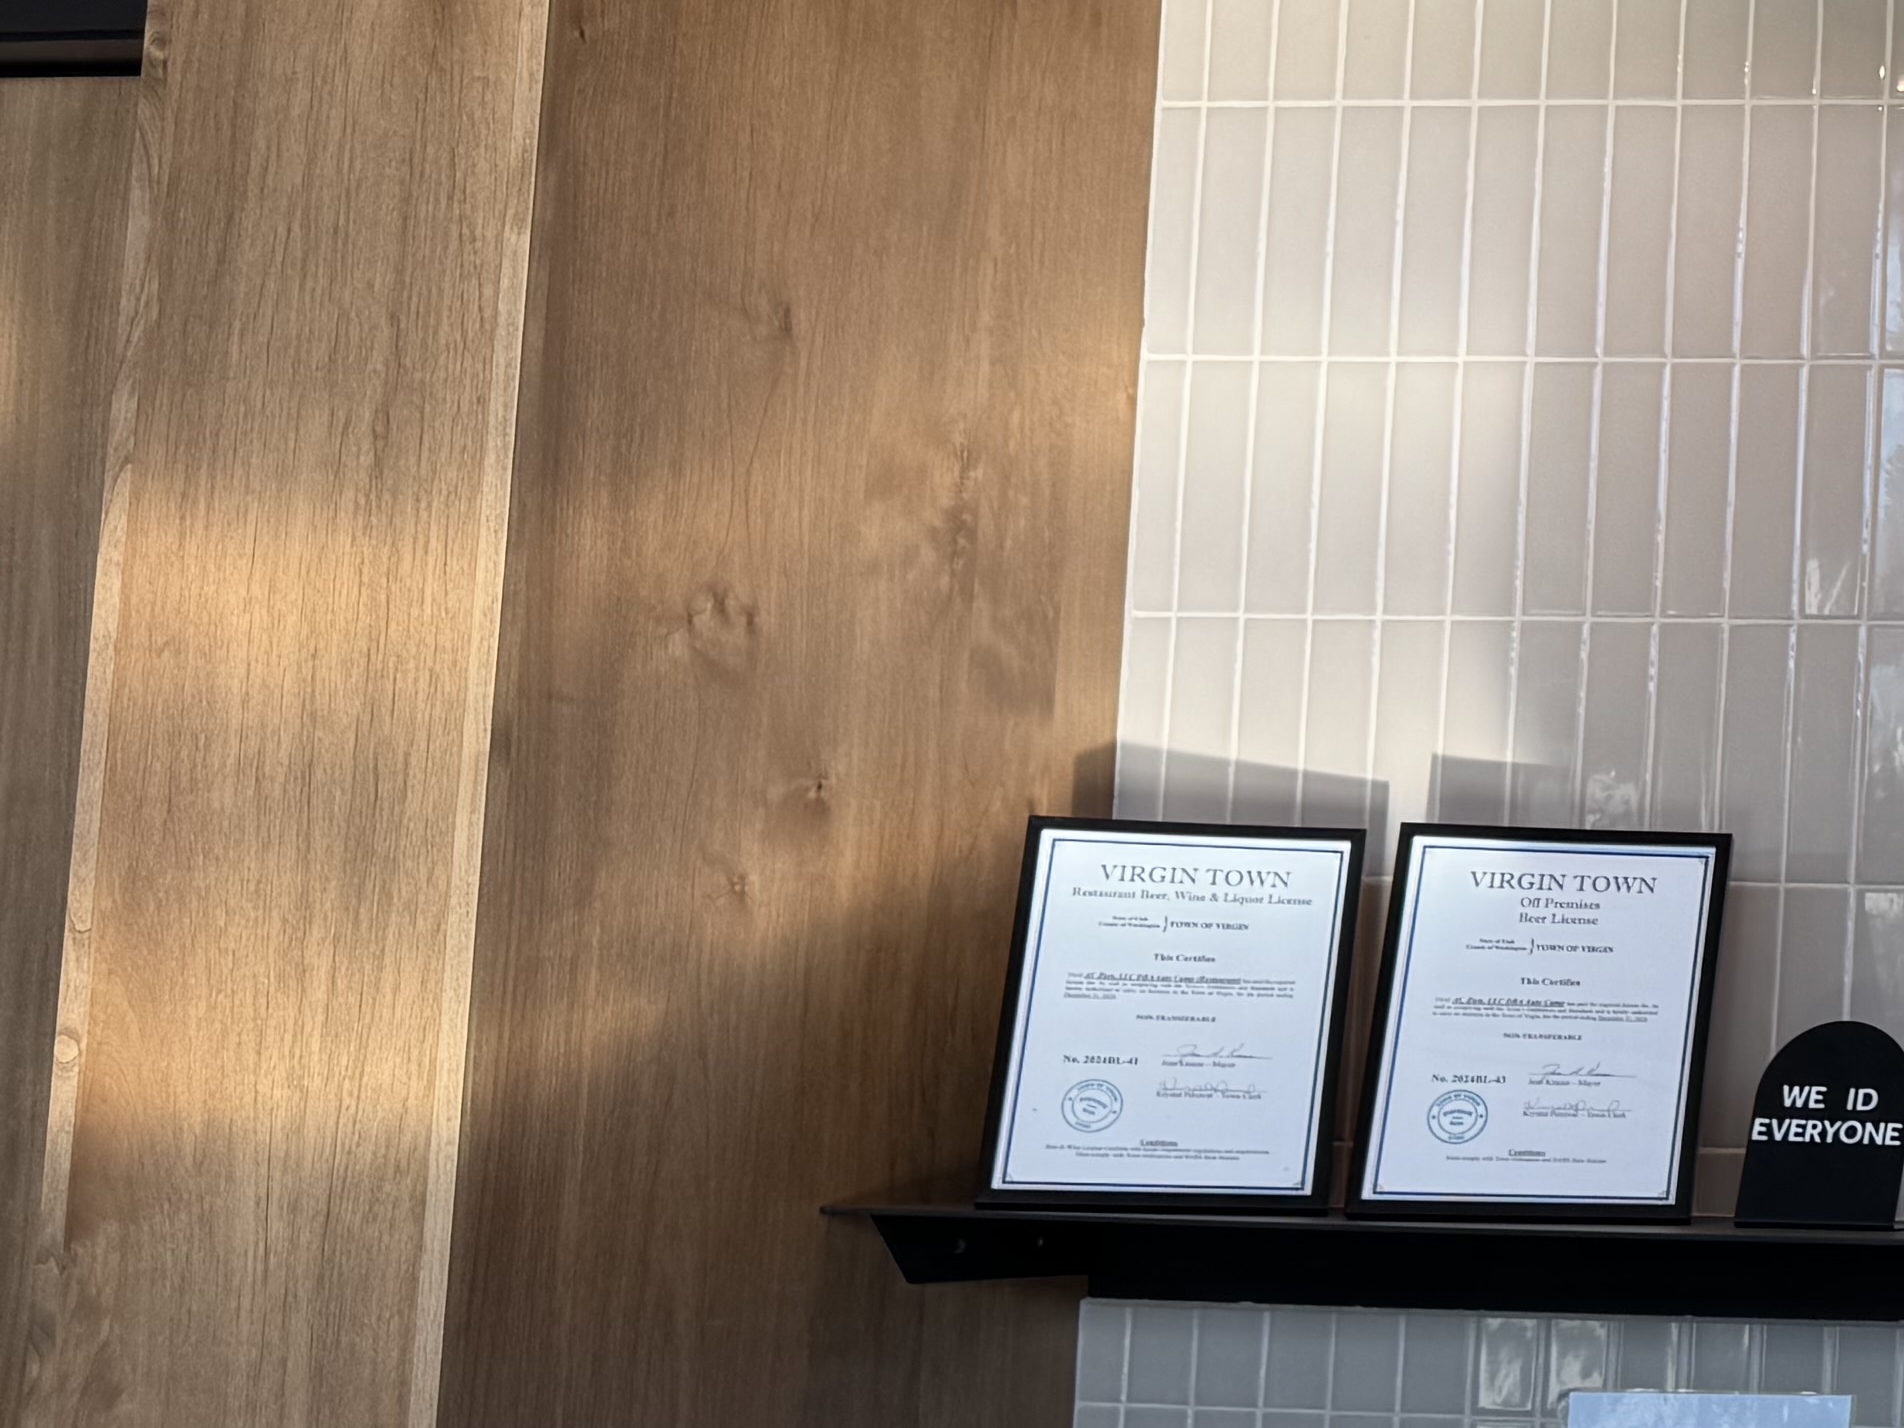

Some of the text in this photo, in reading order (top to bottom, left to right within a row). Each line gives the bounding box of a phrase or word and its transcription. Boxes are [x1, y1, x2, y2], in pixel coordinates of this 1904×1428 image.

[1100, 864, 1292, 887] VIRGIN TOWN
[1470, 871, 1657, 894] VIRGIN TOWN
[1175, 890, 1205, 903] Wine
[1520, 897, 1600, 910] Off Premises
[1519, 913, 1598, 925] Beer License
[1783, 1085, 1879, 1111] WE ID
[1751, 1118, 1903, 1146] EVERYONE
